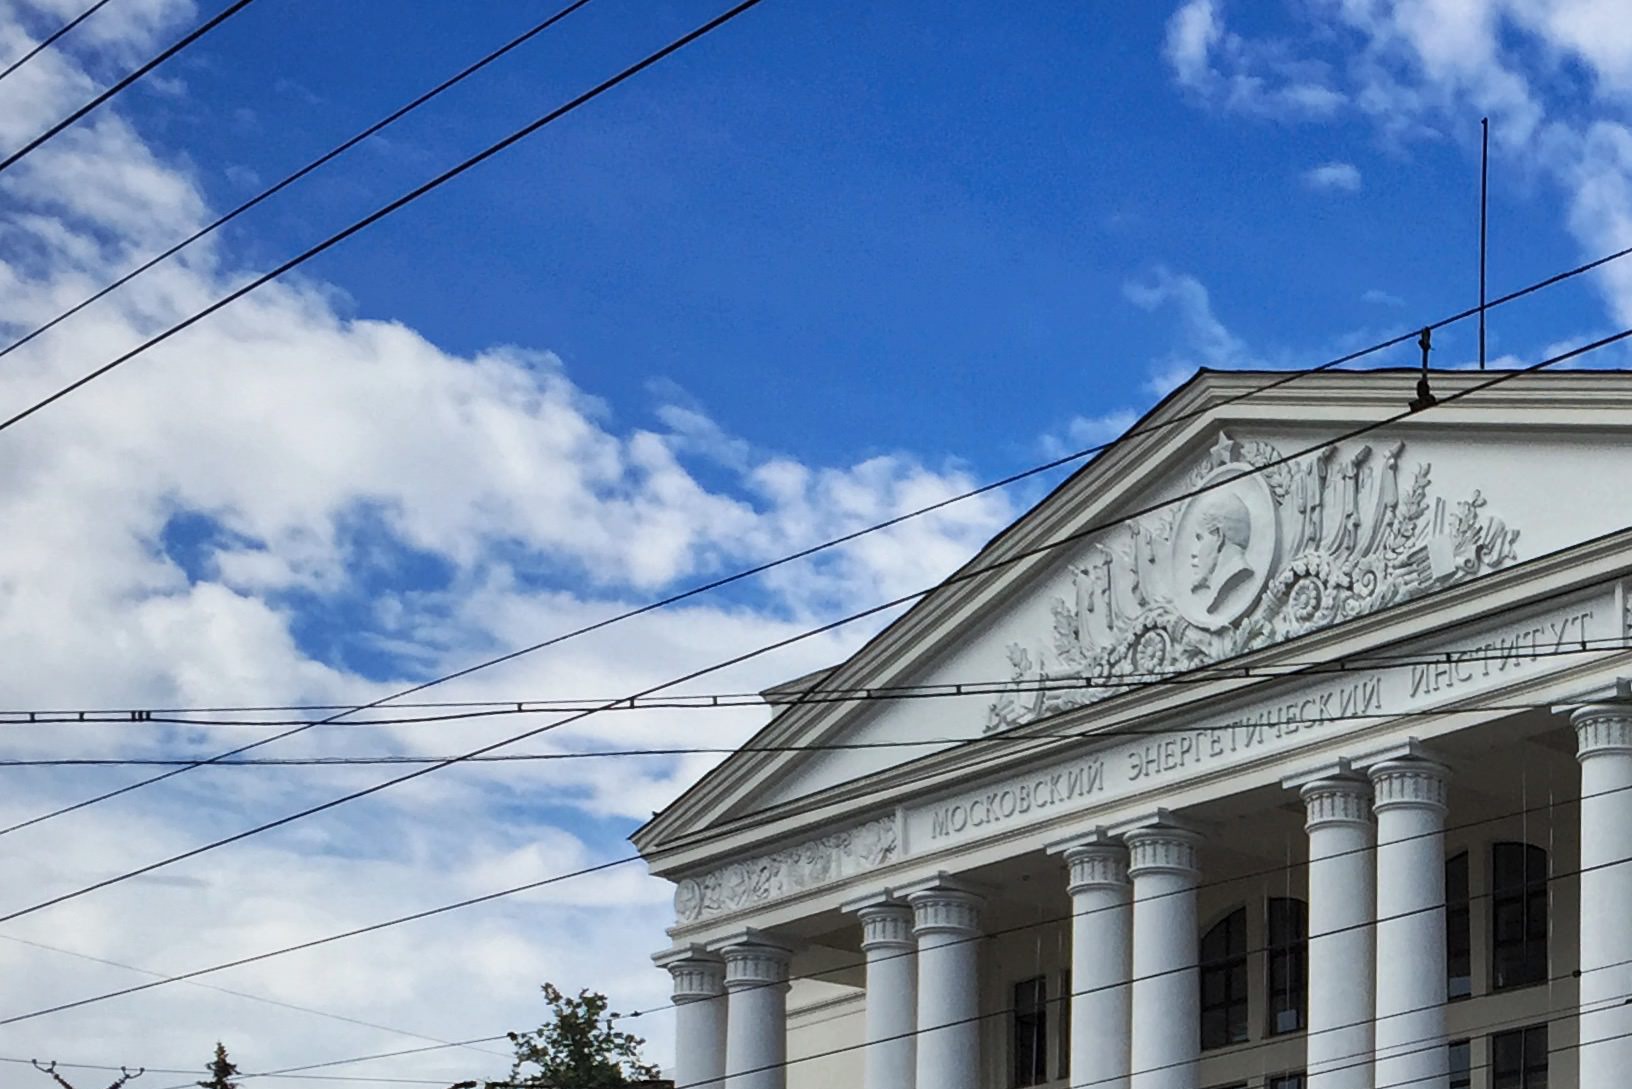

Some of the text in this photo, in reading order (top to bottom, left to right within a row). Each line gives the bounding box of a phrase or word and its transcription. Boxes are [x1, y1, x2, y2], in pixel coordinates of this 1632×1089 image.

[931, 610, 1594, 840] МОСКОВСКИЙ ЭНЕРГЕТИЧЕСКИЙ ИНСТИТУТ
